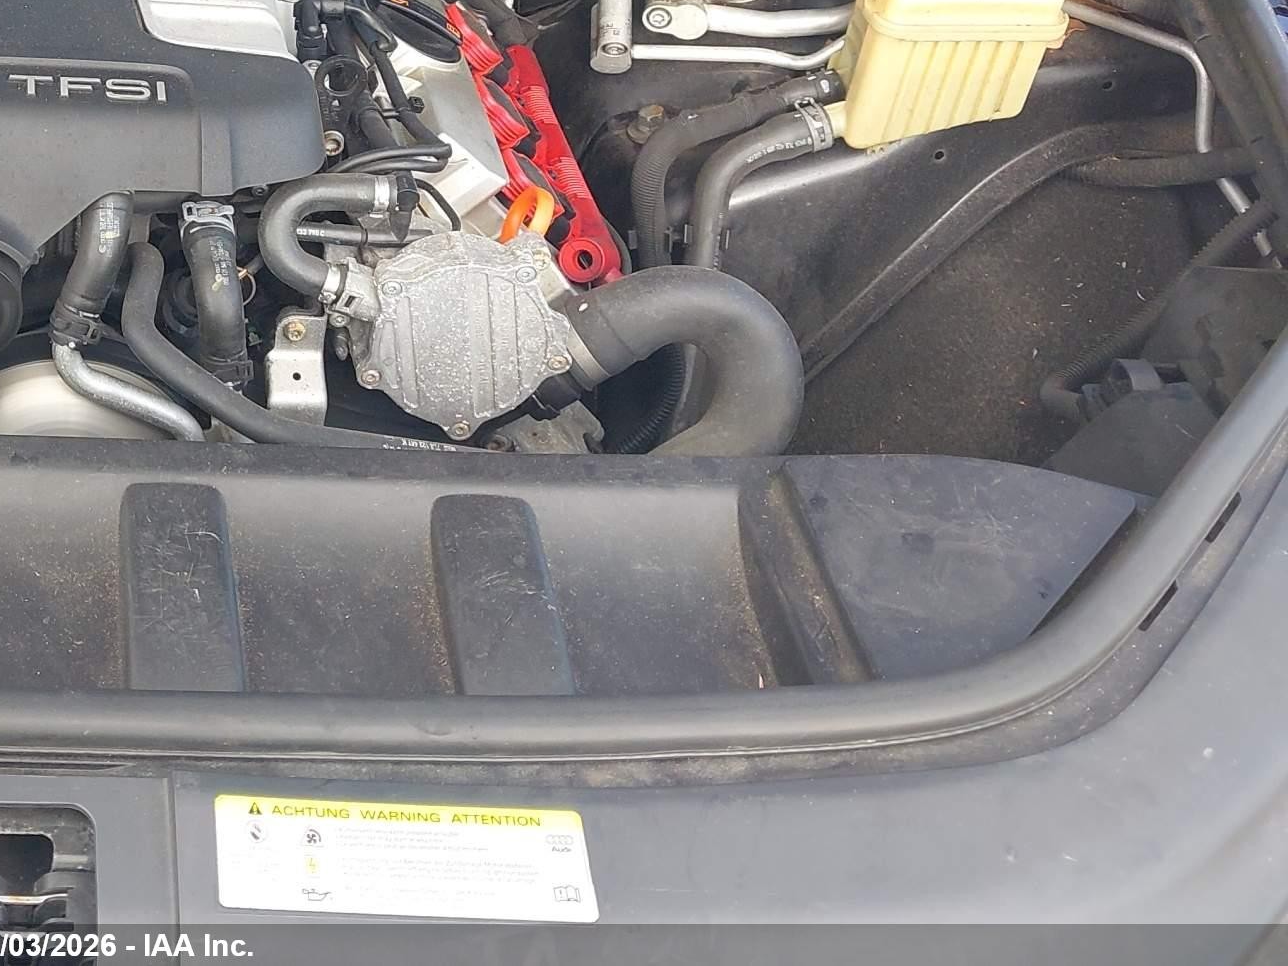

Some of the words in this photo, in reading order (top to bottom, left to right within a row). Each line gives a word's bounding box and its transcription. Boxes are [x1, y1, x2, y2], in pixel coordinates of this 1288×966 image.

[9, 74, 167, 102] TFSI
[272, 805, 350, 819] ACHTUNG
[360, 809, 441, 823] WARNING
[452, 813, 541, 827] ATTENTION
